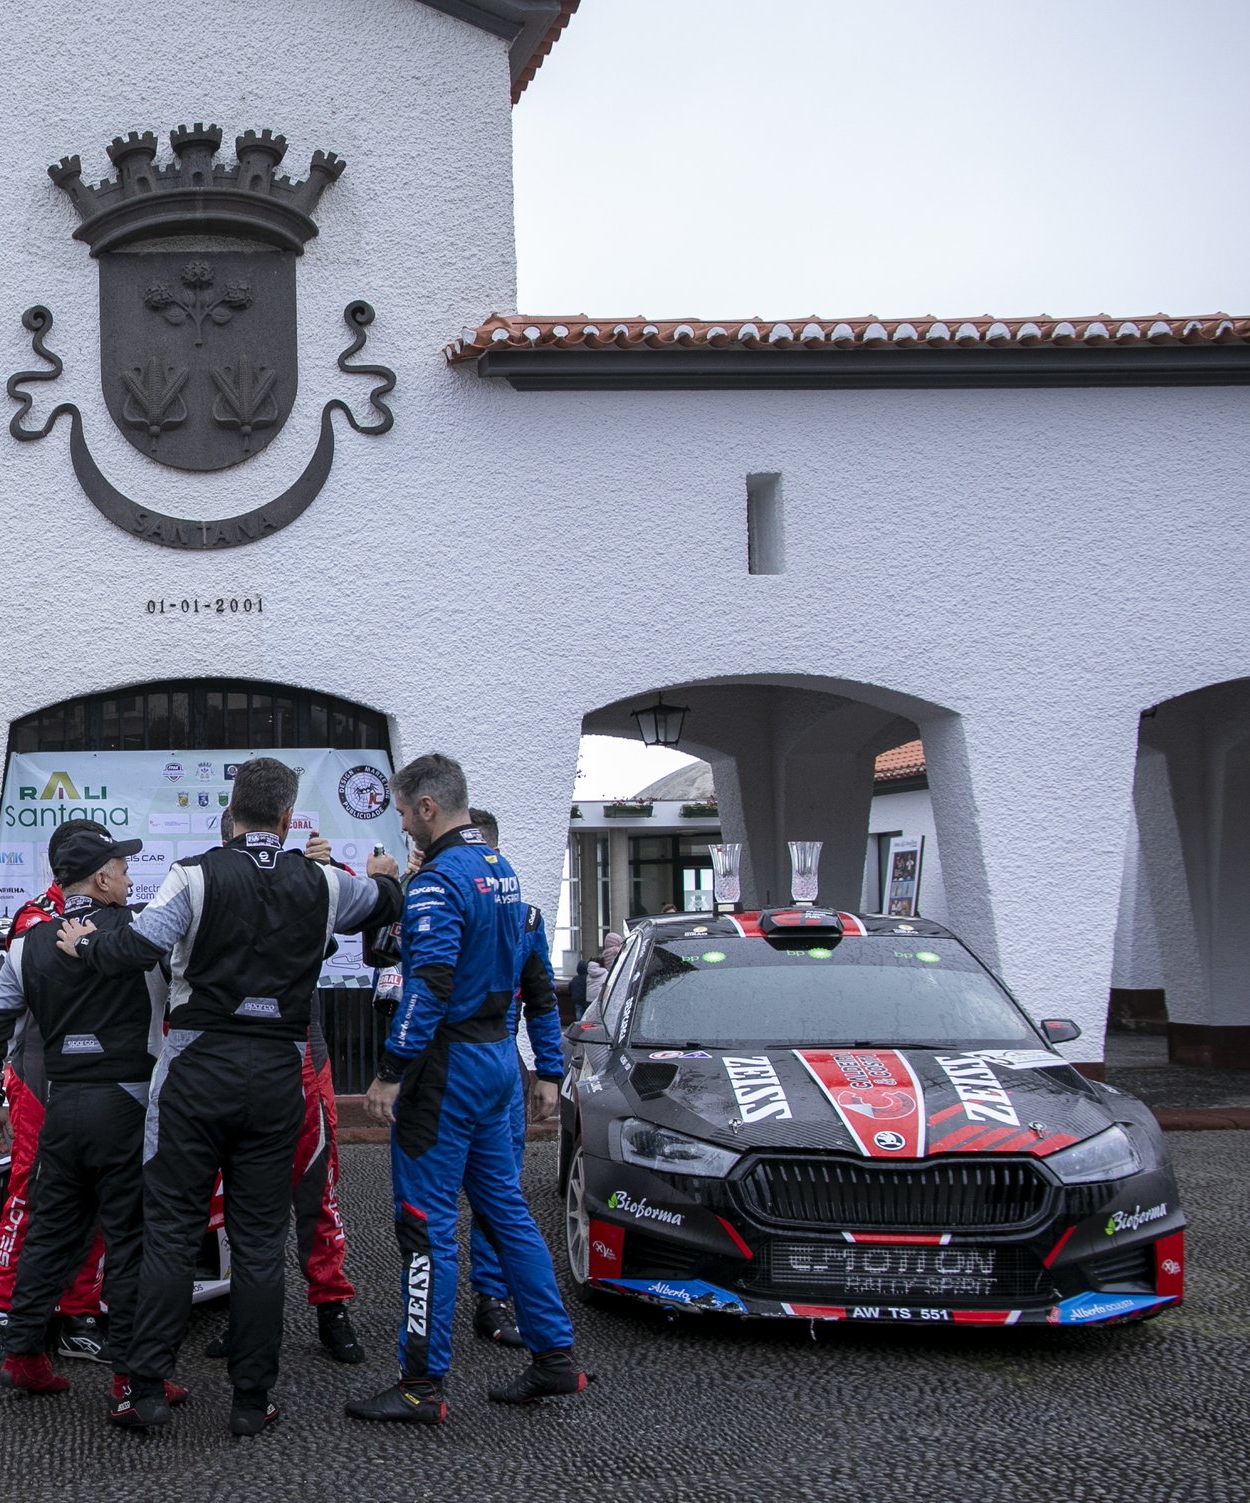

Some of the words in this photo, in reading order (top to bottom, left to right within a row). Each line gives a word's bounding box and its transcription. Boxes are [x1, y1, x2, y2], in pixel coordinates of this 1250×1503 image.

[133, 513, 277, 546] SANTANA
[147, 598, 263, 614] 01-01-2001
[19, 771, 107, 800] RALI
[339, 770, 354, 793] DESIGN
[365, 766, 390, 799] MARKETING
[5, 804, 129, 827] Santana
[343, 801, 385, 819] PUBLICIDADE
[136, 884, 161, 892] electr
[380, 975, 399, 985] ORAL
[245, 1002, 275, 1011] sparco
[67, 1040, 95, 1049] sparco
[722, 1056, 793, 1123] ZEISS
[934, 1056, 1021, 1126] ZEISS
[615, 1191, 683, 1226] Bioforma
[1112, 1203, 1167, 1231] Bioforma
[788, 1246, 997, 1274] EMOTION
[406, 1252, 431, 1337] ZEISS
[648, 1282, 690, 1303] Alberto
[853, 1307, 879, 1318] AW
[888, 1308, 911, 1319] TS
[920, 1309, 949, 1320] 551
[1070, 1304, 1106, 1321] Alberto
